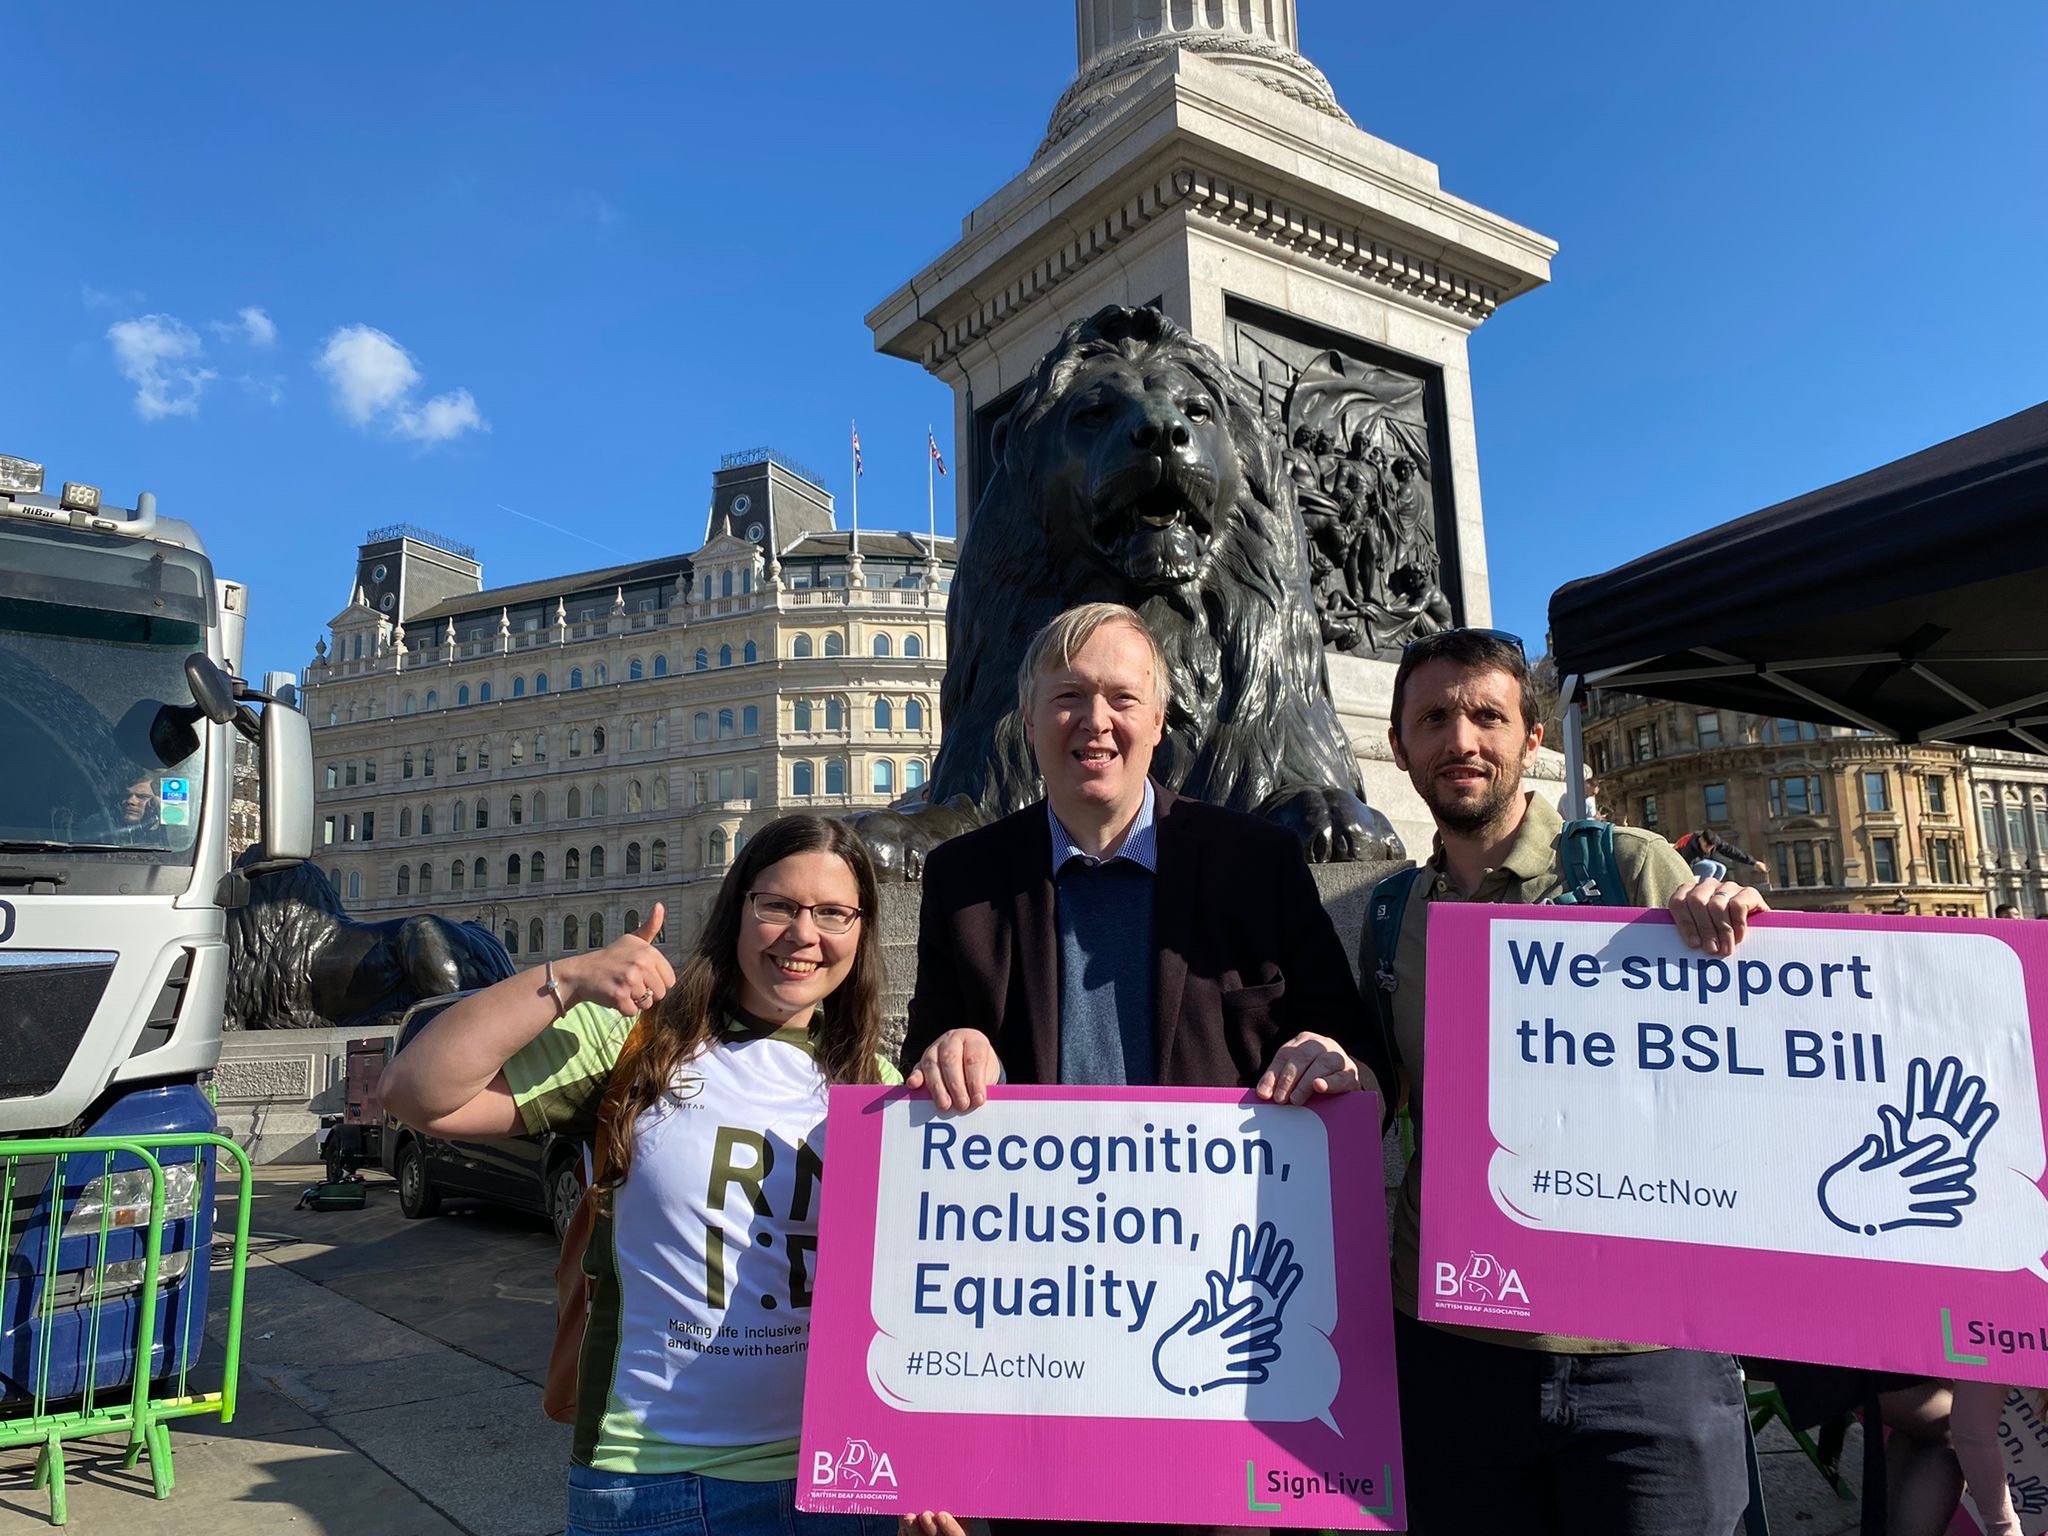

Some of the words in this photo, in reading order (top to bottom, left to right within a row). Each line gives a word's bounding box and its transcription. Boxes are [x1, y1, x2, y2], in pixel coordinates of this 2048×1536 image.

[22, 506, 55, 518] HiBar
[1508, 940, 1602, 988] We
[1620, 953, 1873, 1006] support
[1517, 1018, 1616, 1068] the
[1637, 1022, 1765, 1076] BSL
[1785, 1030, 1886, 1083] Bill
[921, 1121, 1292, 1184] Recognition,
[1532, 1169, 1738, 1209] #BSLActNow
[918, 1191, 1200, 1252] Inclusion,
[914, 1262, 1158, 1333] Equality
[1435, 1302, 1463, 1311] BRITISH
[1463, 1304, 1482, 1312] DEAF
[1483, 1307, 1531, 1317] ASSOCIATION
[668, 1318, 712, 1338] Making
[718, 1325, 738, 1338] life
[744, 1325, 802, 1338] inclusive
[668, 1338, 691, 1350] and
[693, 1341, 730, 1356] those
[732, 1344, 763, 1357] with
[765, 1341, 809, 1356] hearin
[906, 1350, 1086, 1379] #BSLActNow
[811, 1491, 836, 1499] BRITISH
[854, 1493, 898, 1501] ASSOCIATION
